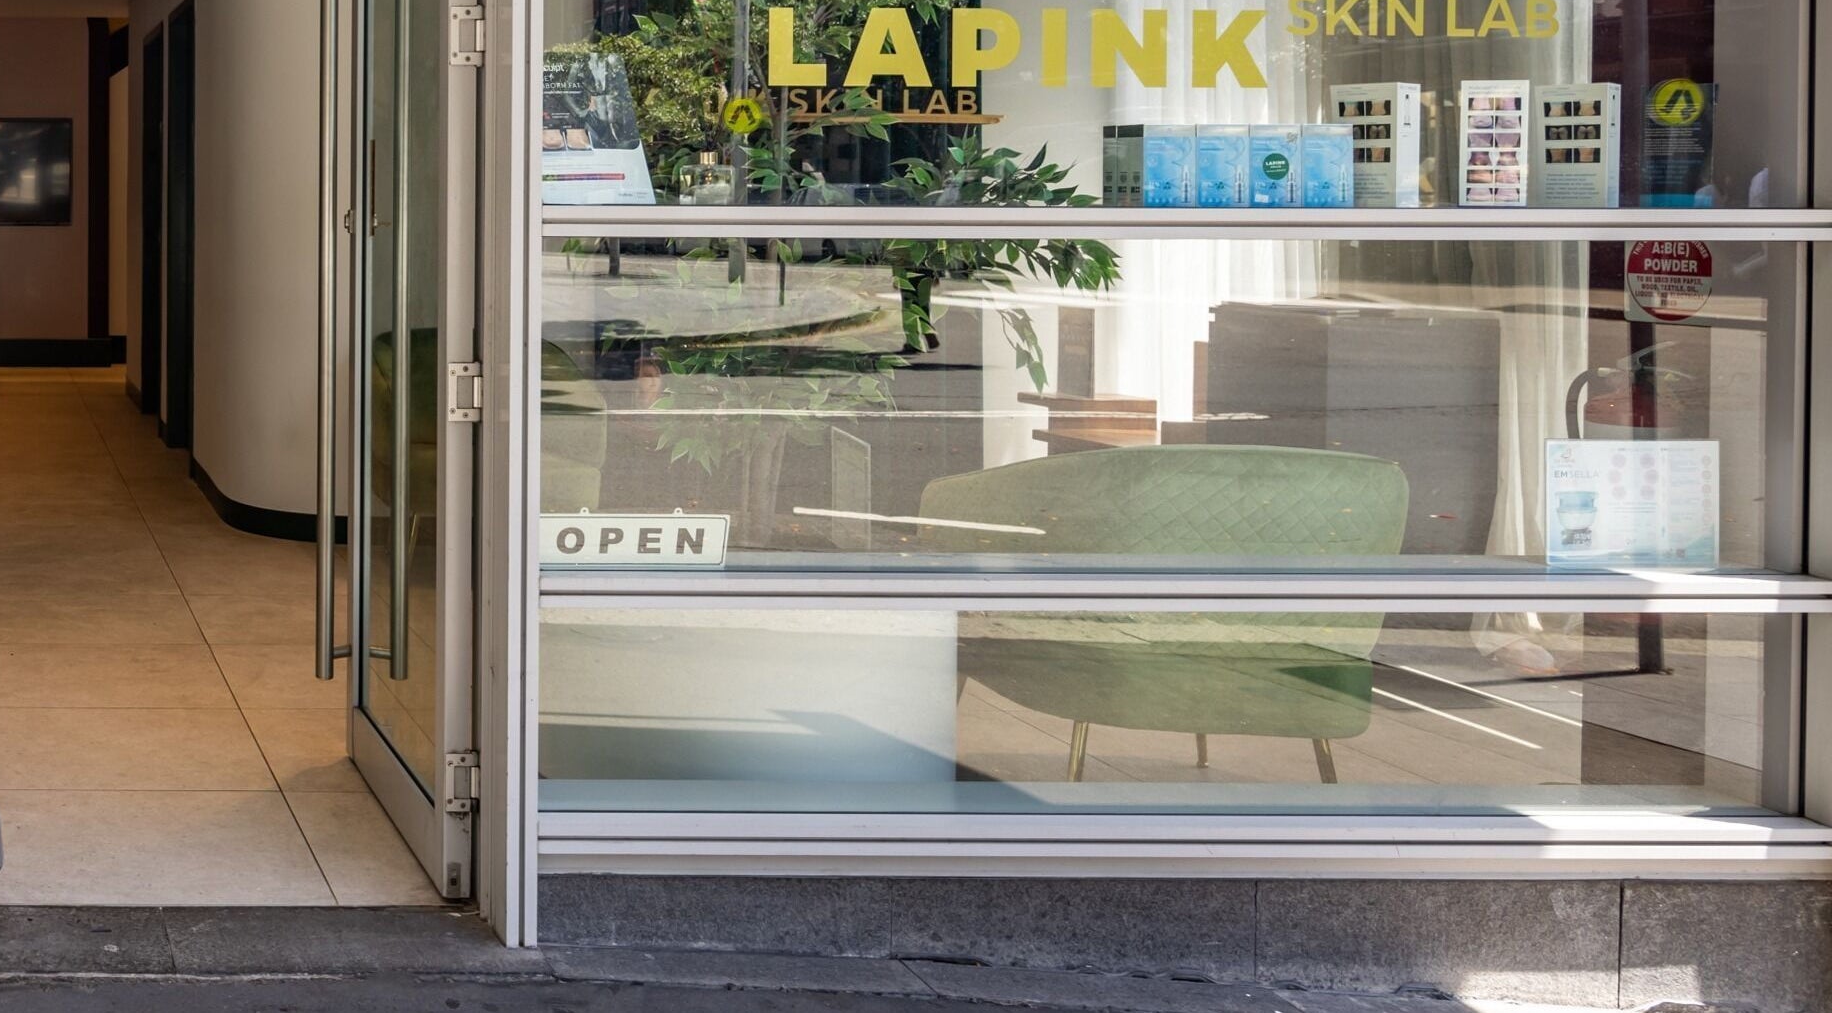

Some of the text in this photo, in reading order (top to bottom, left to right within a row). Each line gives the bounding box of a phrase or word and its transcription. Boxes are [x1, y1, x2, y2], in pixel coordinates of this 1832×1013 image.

[768, 7, 1267, 88] LAPINK
[903, 89, 978, 115] LAB
[1652, 241, 1690, 258] A:B(E)
[1644, 258, 1698, 273] POWDER
[556, 526, 705, 555] OPEN
